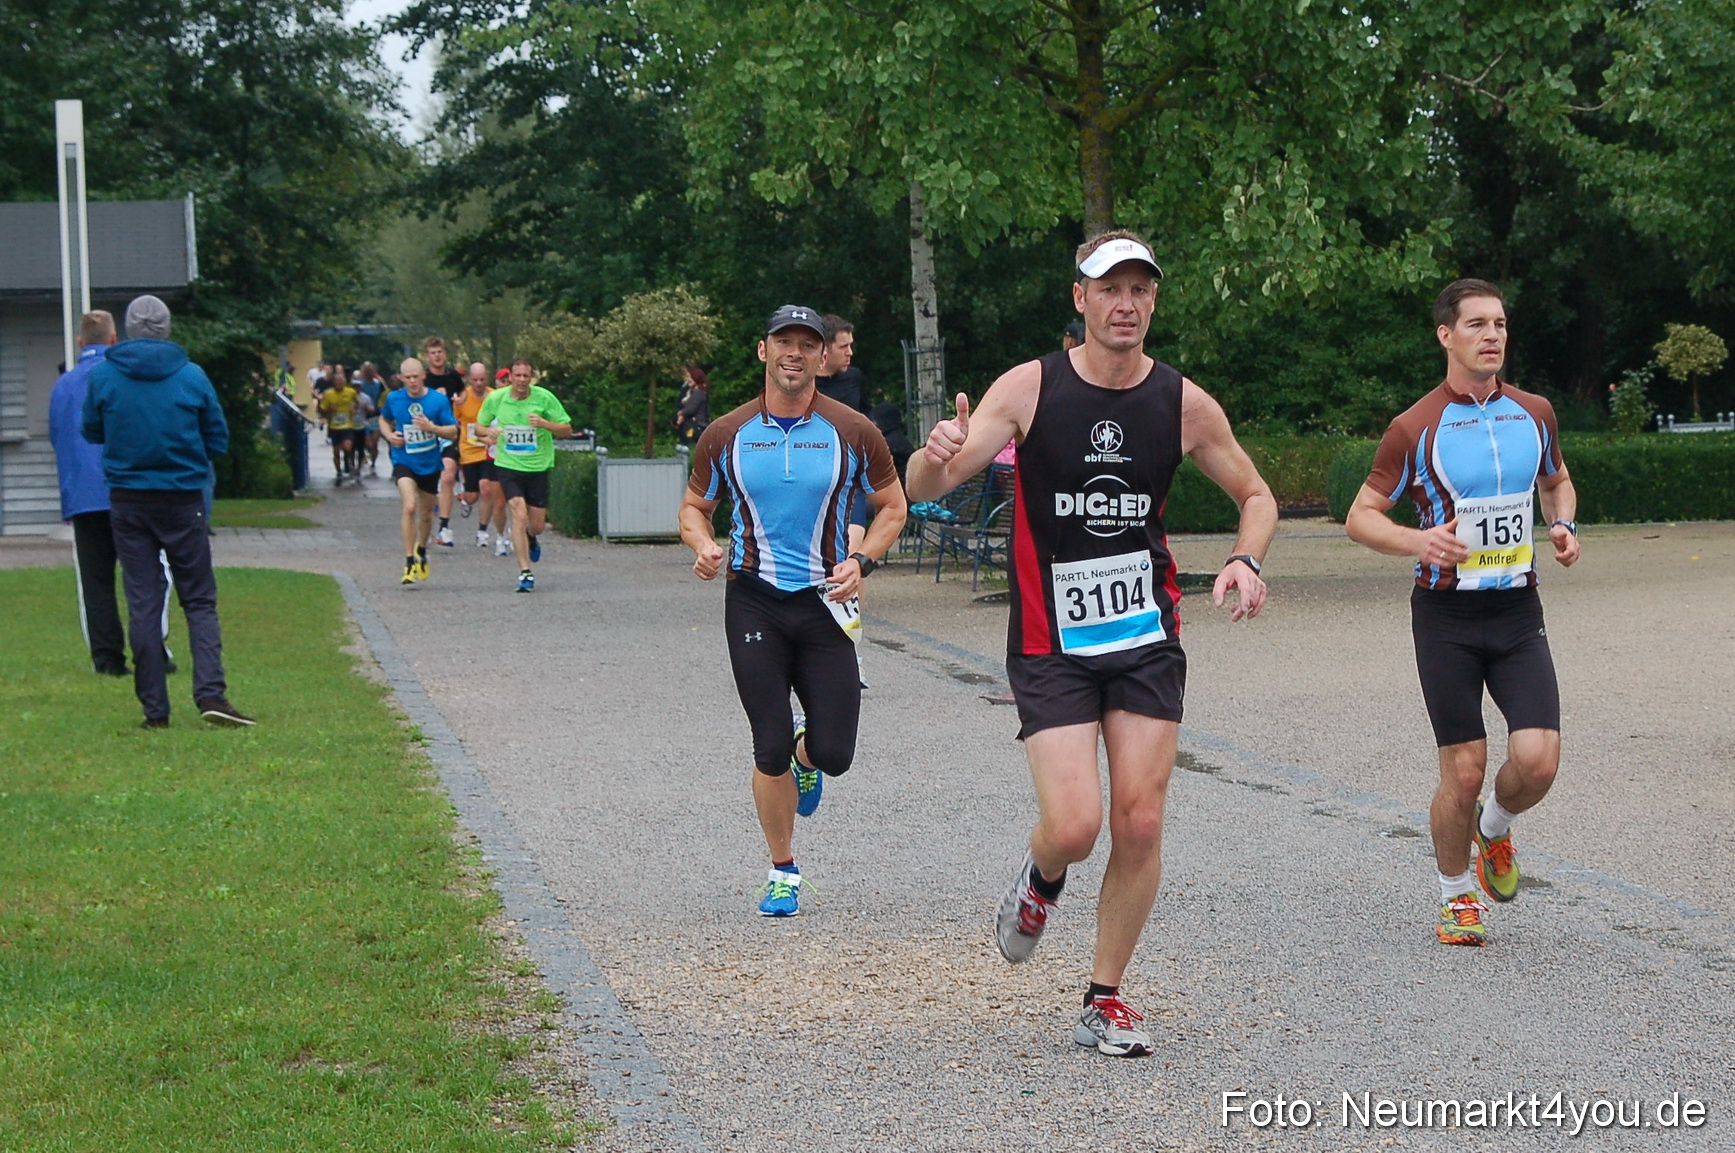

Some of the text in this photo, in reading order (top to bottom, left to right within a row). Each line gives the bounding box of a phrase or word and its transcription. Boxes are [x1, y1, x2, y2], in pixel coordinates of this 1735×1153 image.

[507, 432, 534, 443] 2114
[1457, 501, 1524, 515] PARTL Neumarkt
[1476, 513, 1523, 546] 153
[1055, 563, 1137, 582] PARTL Neumarkt
[1066, 576, 1146, 622] 3104
